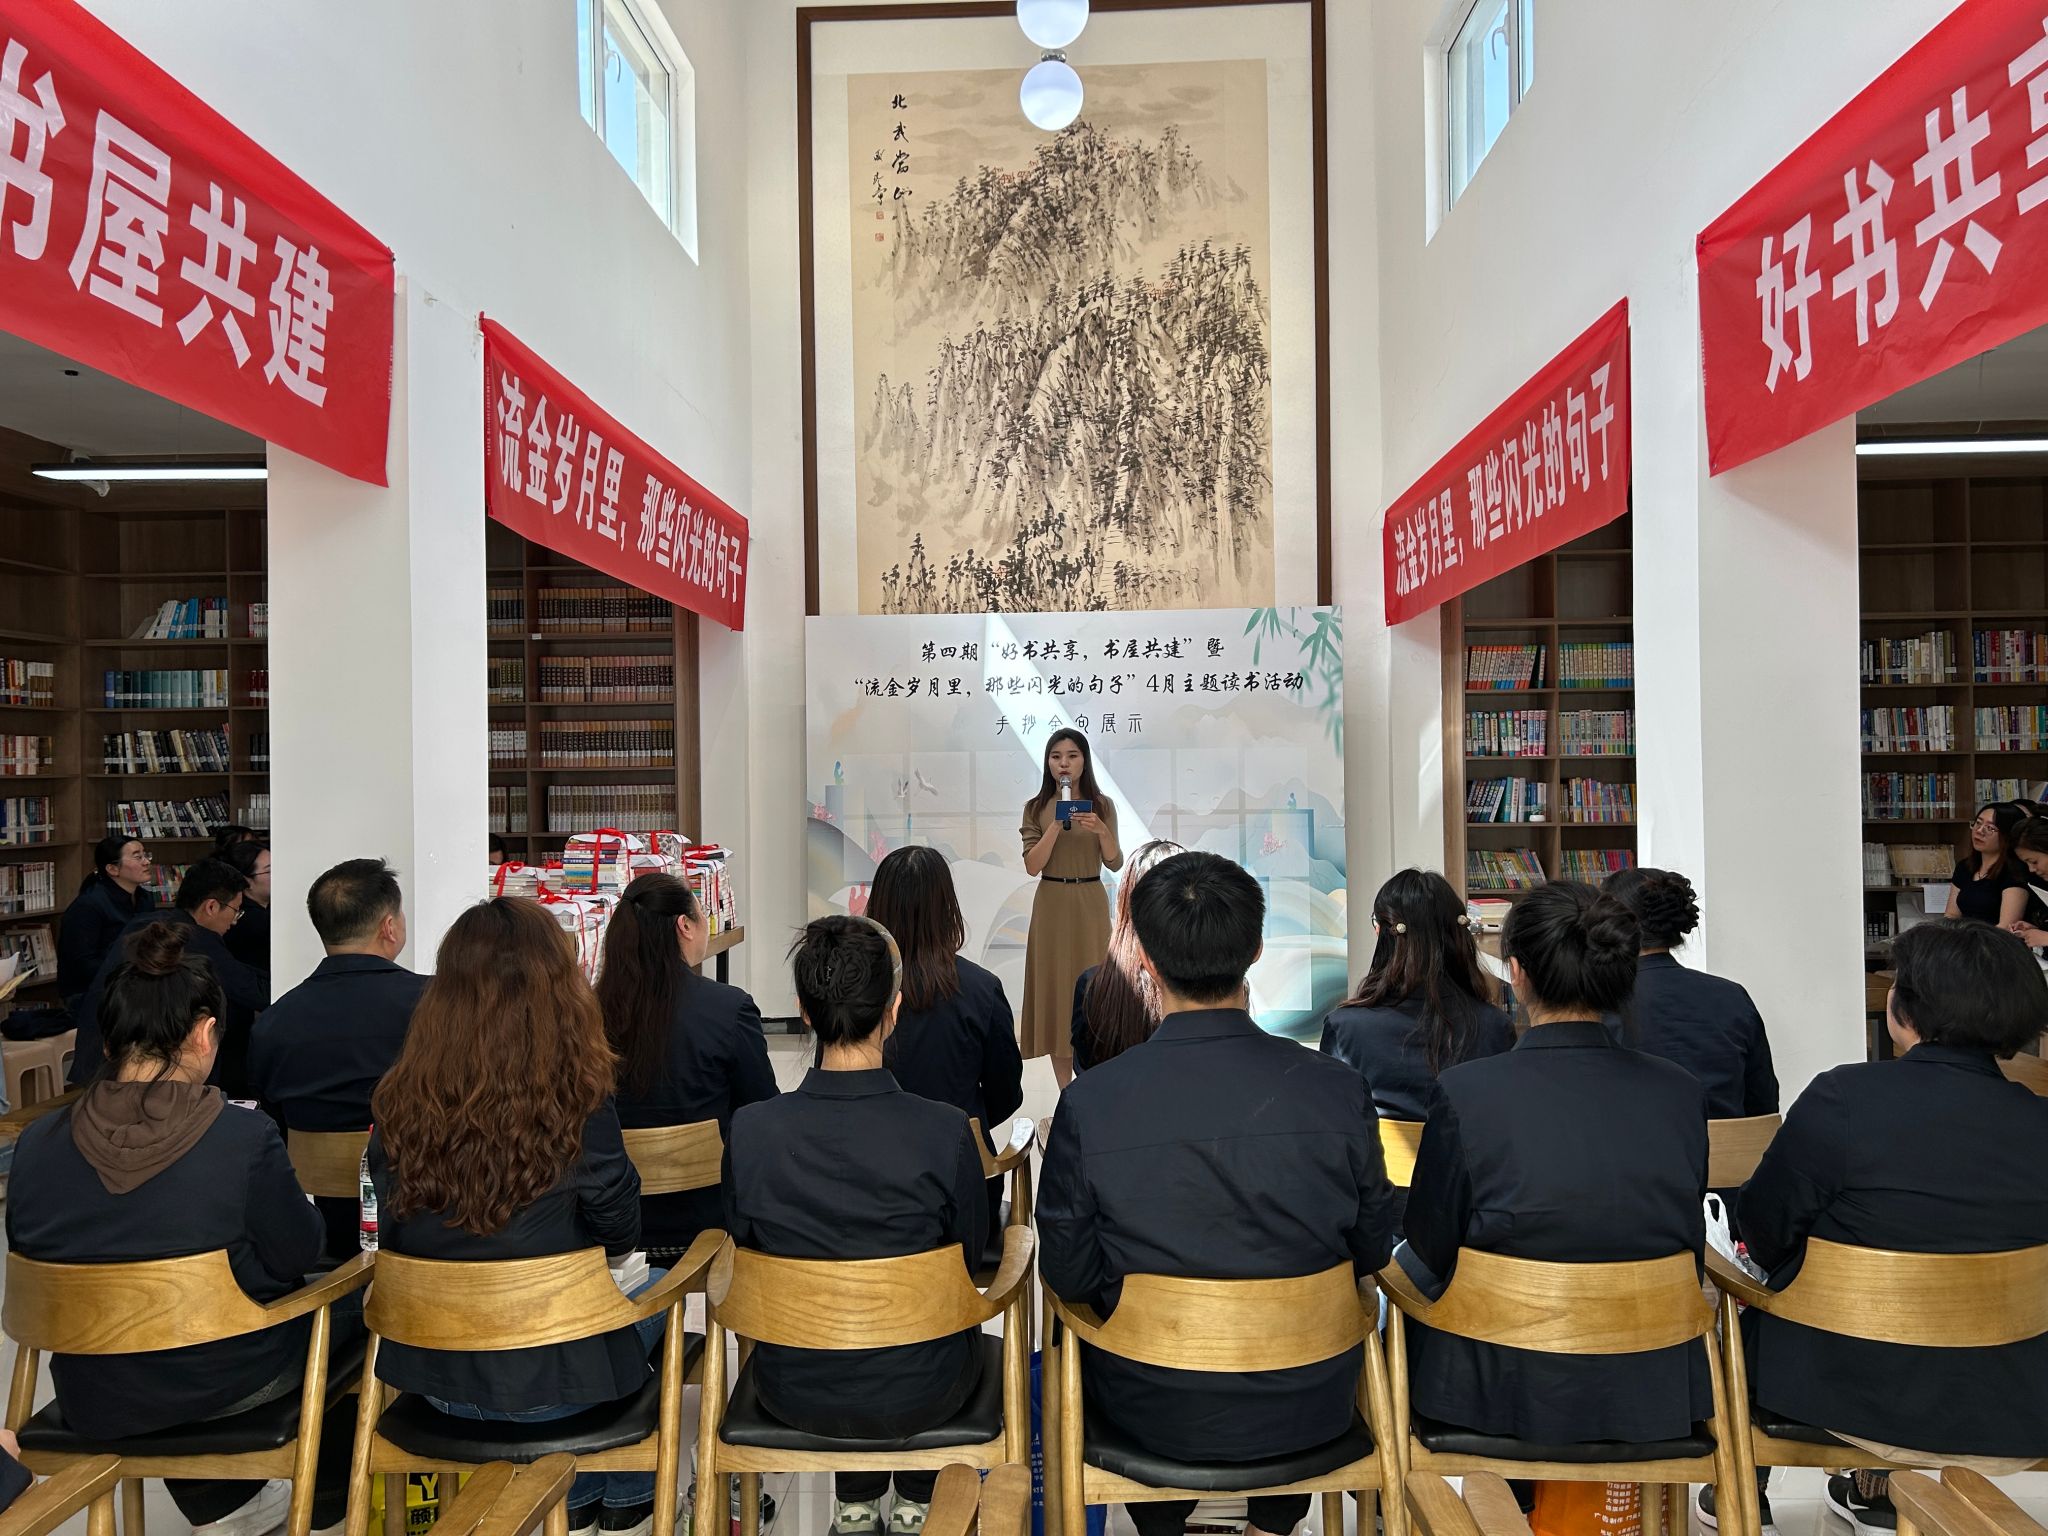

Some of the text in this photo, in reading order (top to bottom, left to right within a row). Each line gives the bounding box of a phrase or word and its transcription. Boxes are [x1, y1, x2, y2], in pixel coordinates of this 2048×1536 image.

[0, 37, 334, 408] 书屋共建
[497, 370, 743, 603] 流金岁月里，那些闪光的句子
[1394, 361, 1614, 597] 流金岁月里，那些闪光的句子
[995, 712, 1143, 736] 手抄金句展示
